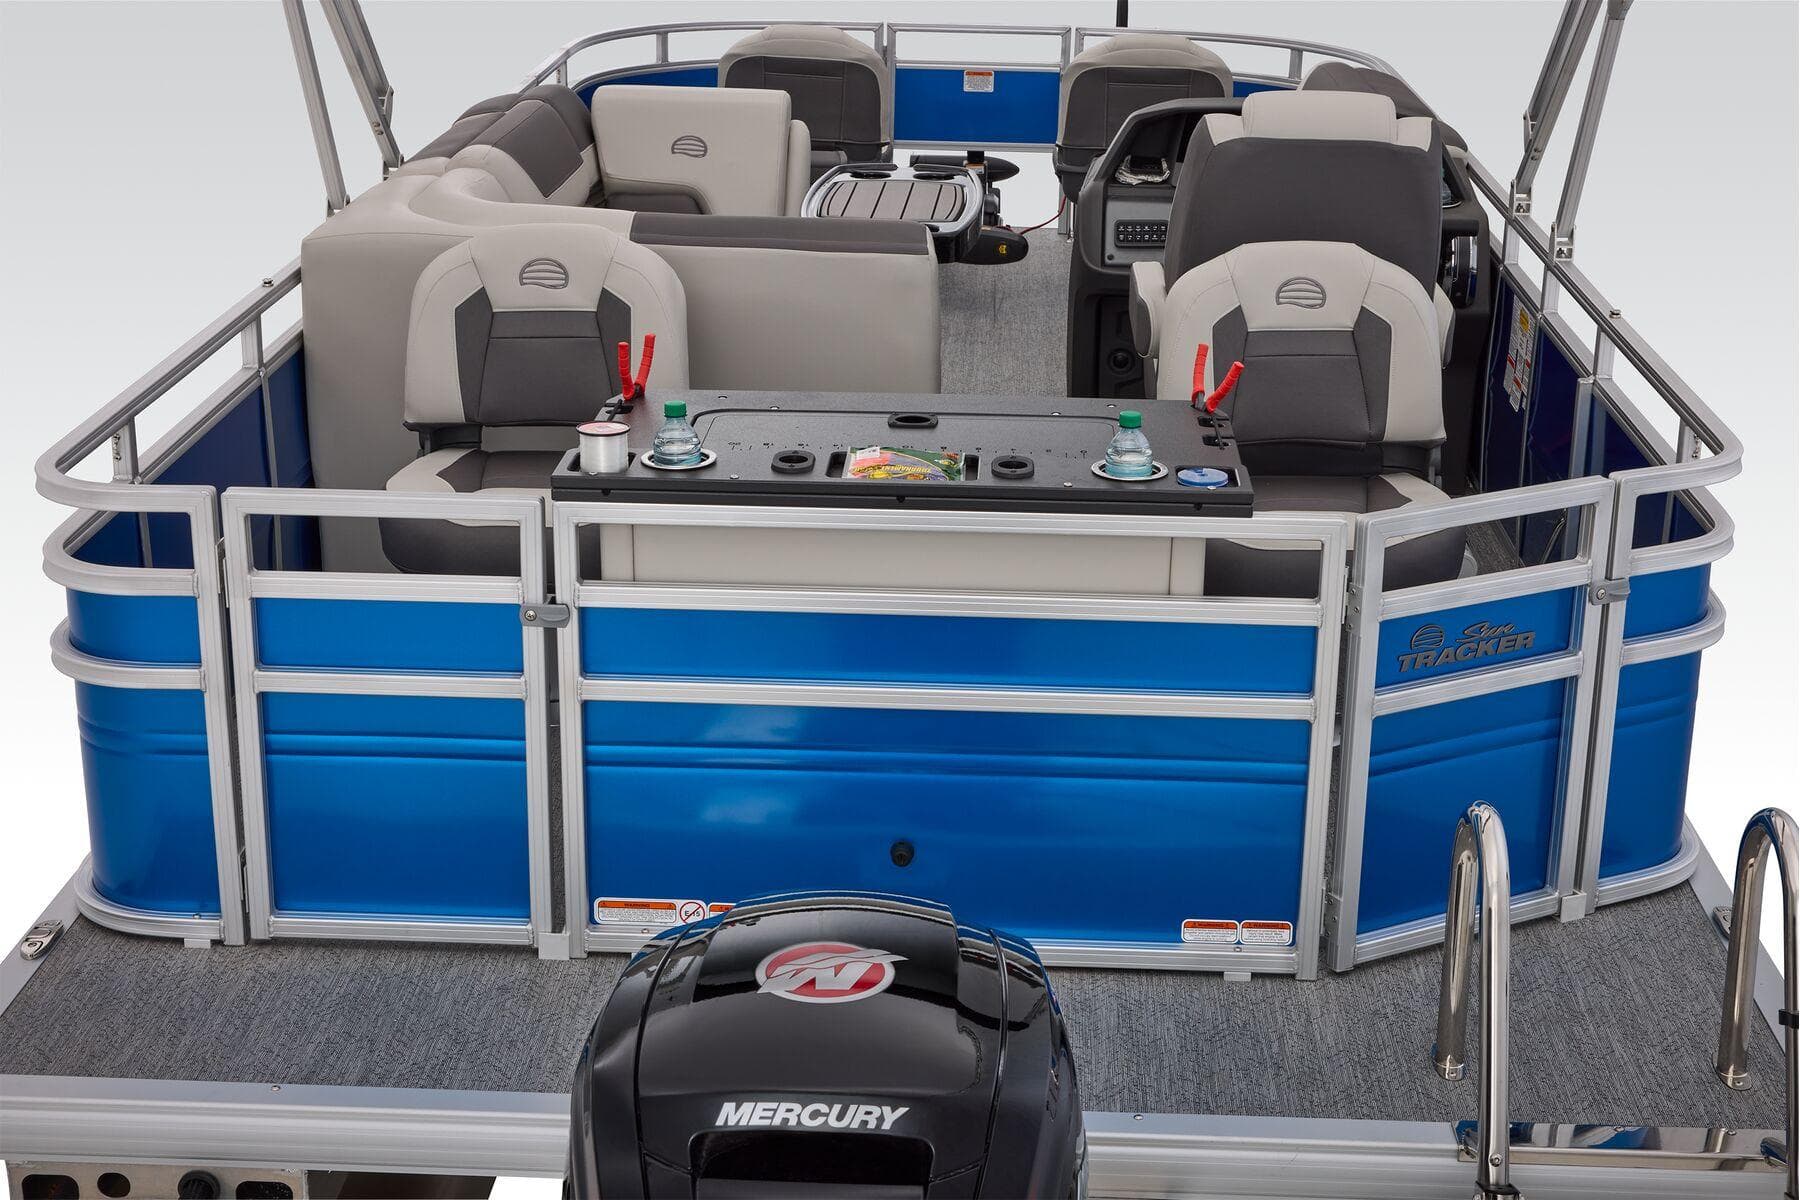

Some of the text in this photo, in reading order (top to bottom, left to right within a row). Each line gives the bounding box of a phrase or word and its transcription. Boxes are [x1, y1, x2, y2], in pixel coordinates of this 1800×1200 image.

[1456, 620, 1515, 643] Sun
[1397, 631, 1535, 672] TRACKER
[715, 1102, 910, 1130] MERCURY
